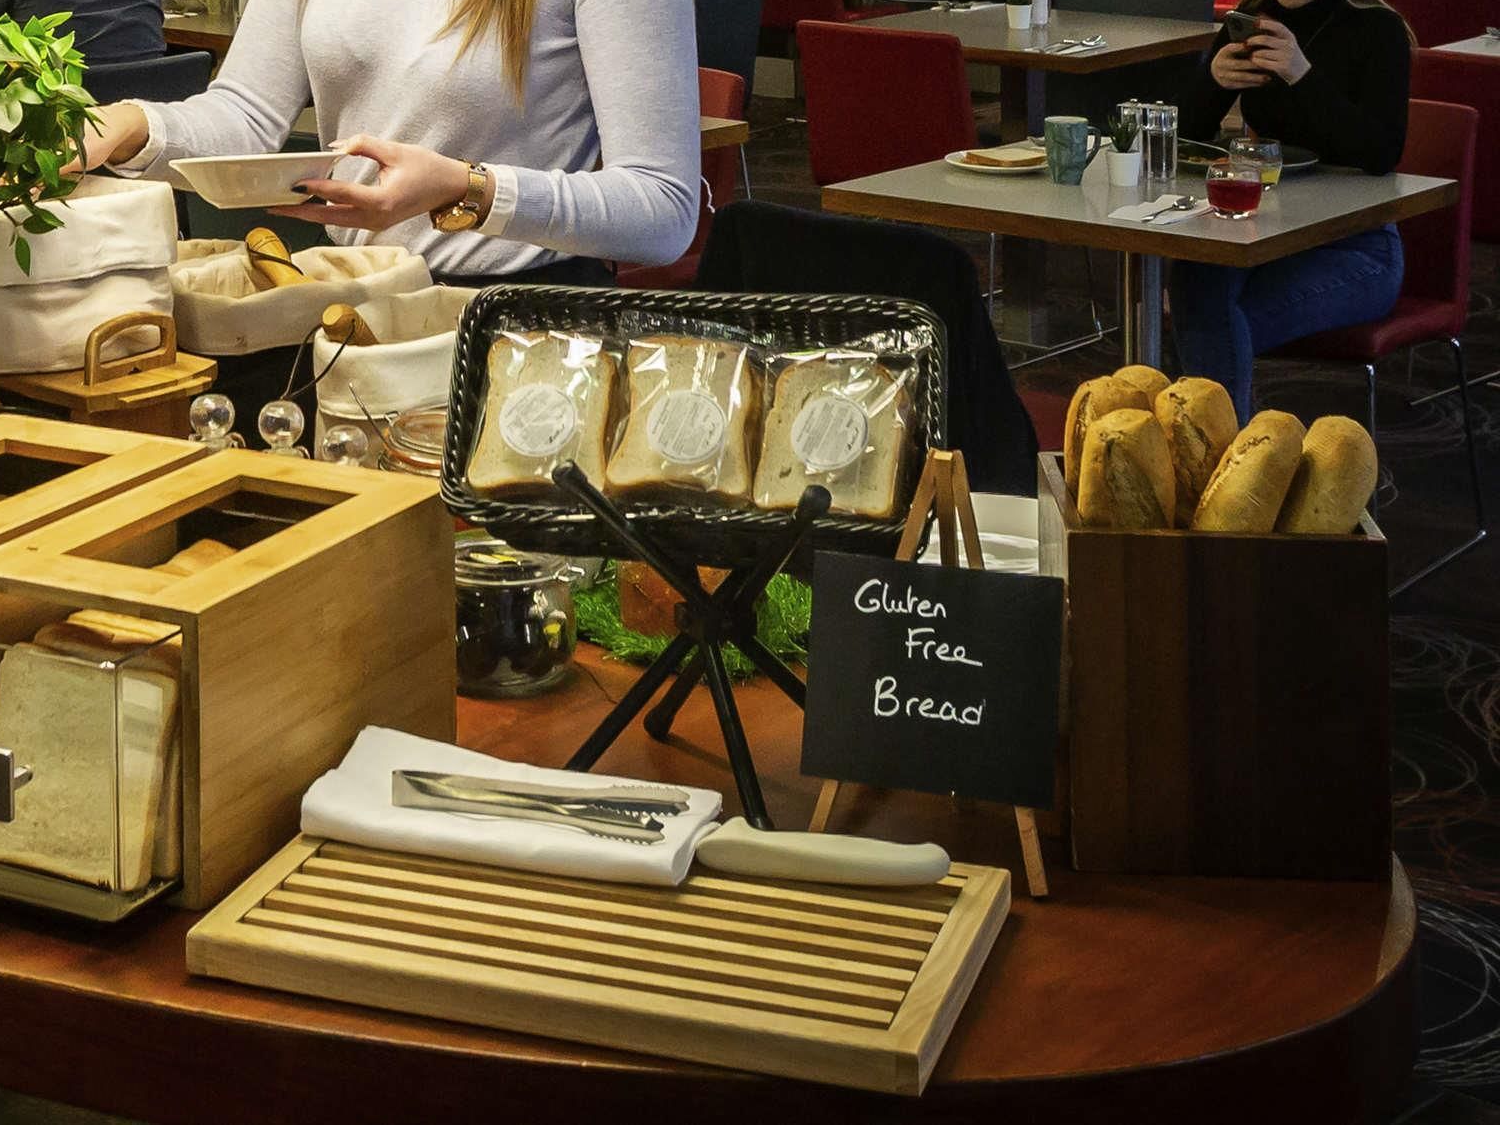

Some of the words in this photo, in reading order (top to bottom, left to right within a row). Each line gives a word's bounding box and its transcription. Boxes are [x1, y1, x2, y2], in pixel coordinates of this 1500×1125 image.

[855, 579, 946, 617] Gluten
[905, 628, 982, 666] Free
[874, 676, 985, 725] Bread
